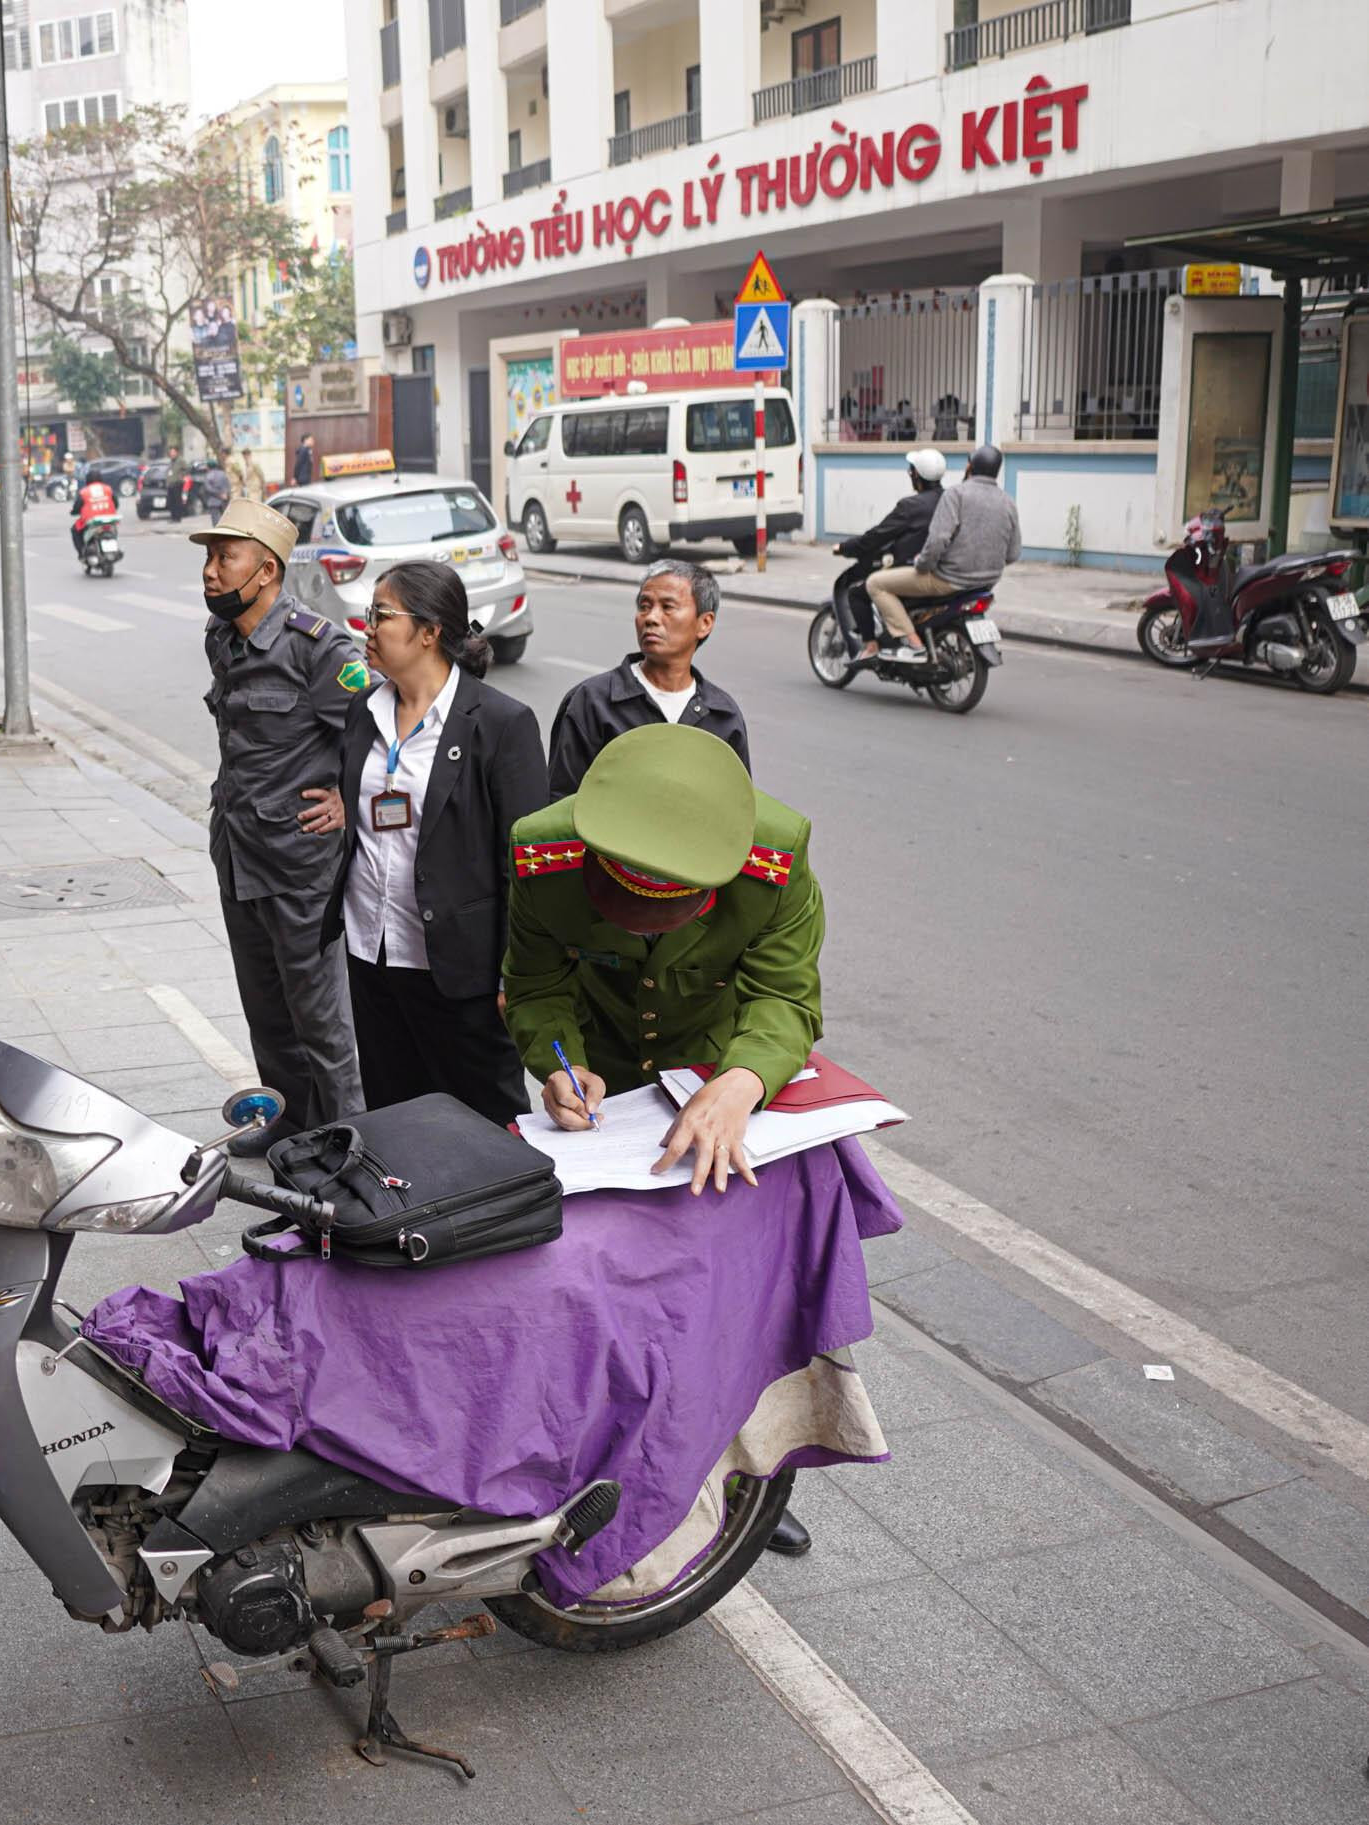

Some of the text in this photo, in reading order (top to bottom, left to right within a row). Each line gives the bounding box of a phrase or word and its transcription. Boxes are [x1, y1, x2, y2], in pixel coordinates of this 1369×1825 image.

[436, 75, 1089, 282] TRƯỜNG TIỂU HỌC LÝ THƯỜNG KIỆT
[41, 1420, 116, 1457] HONDA
